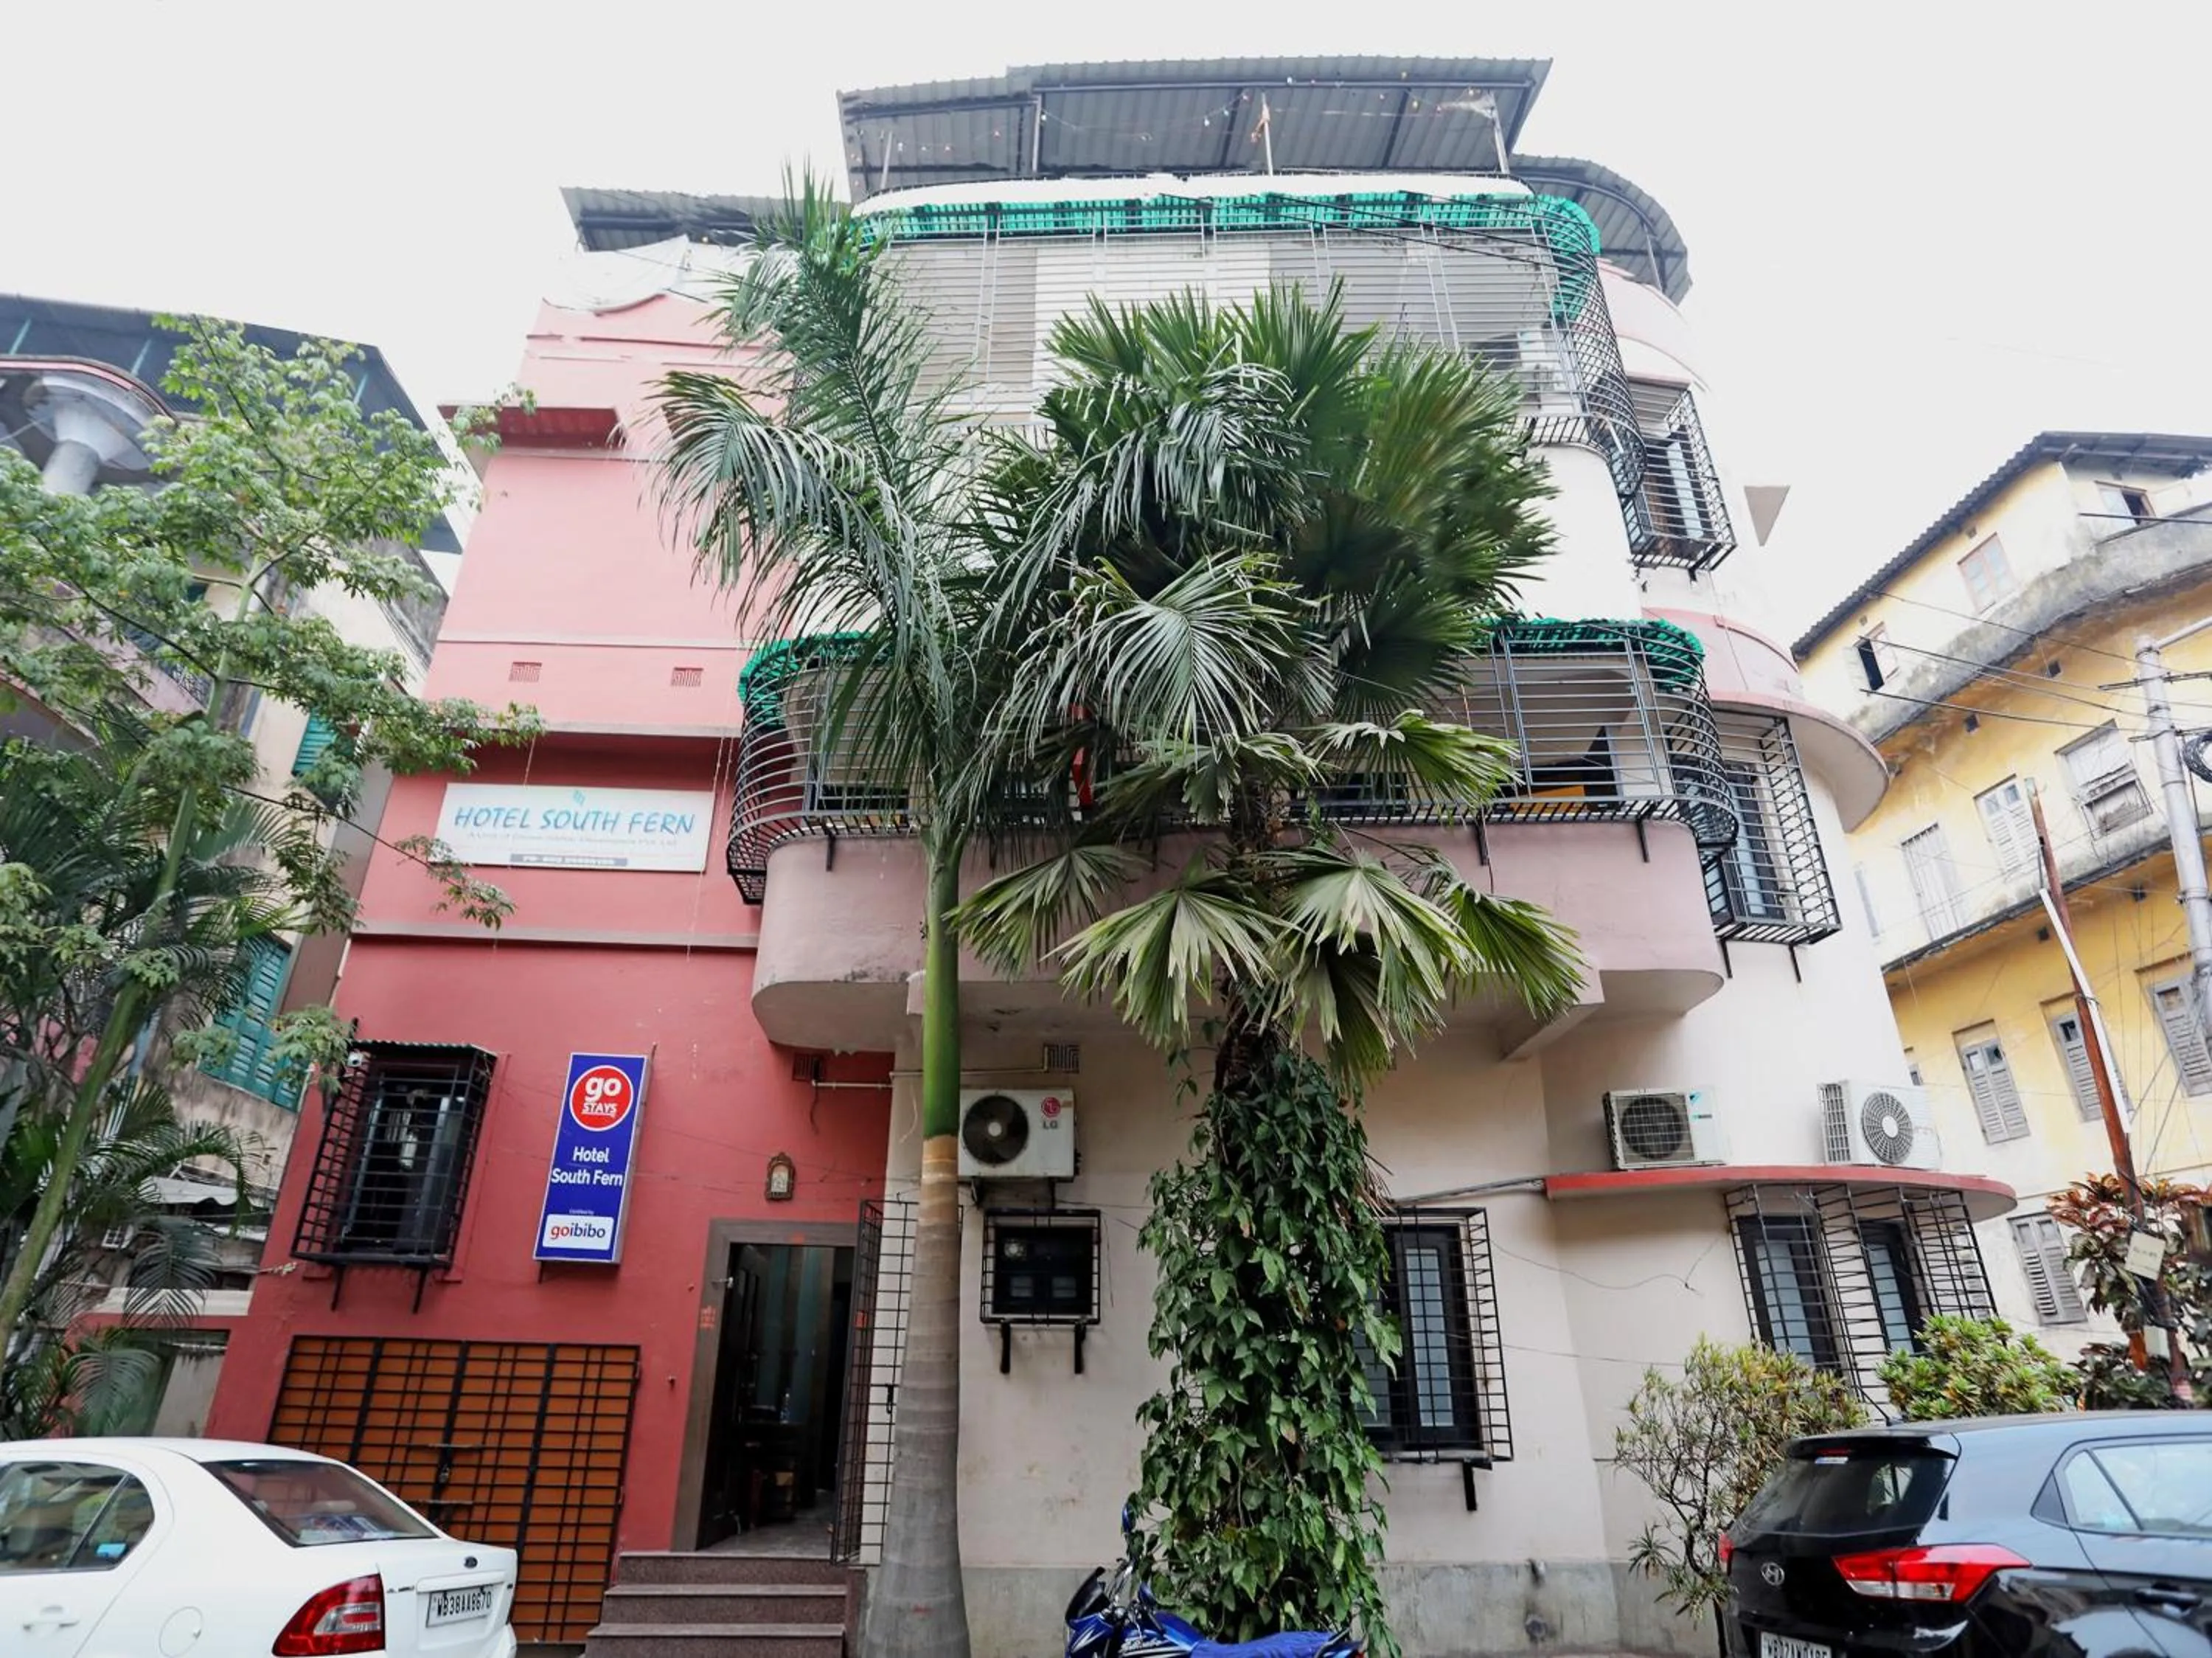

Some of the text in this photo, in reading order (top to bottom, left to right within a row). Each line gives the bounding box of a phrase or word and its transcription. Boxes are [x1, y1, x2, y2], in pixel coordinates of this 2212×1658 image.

[454, 807, 695, 836] HOTEL SOUTH FERN
[585, 1076, 622, 1102] go
[581, 1102, 618, 1114] STAYS
[1043, 1120, 1059, 1129] LG
[572, 1146, 610, 1163] Hotel
[551, 1168, 623, 1187] South Fern
[550, 1222, 606, 1240] goibibo
